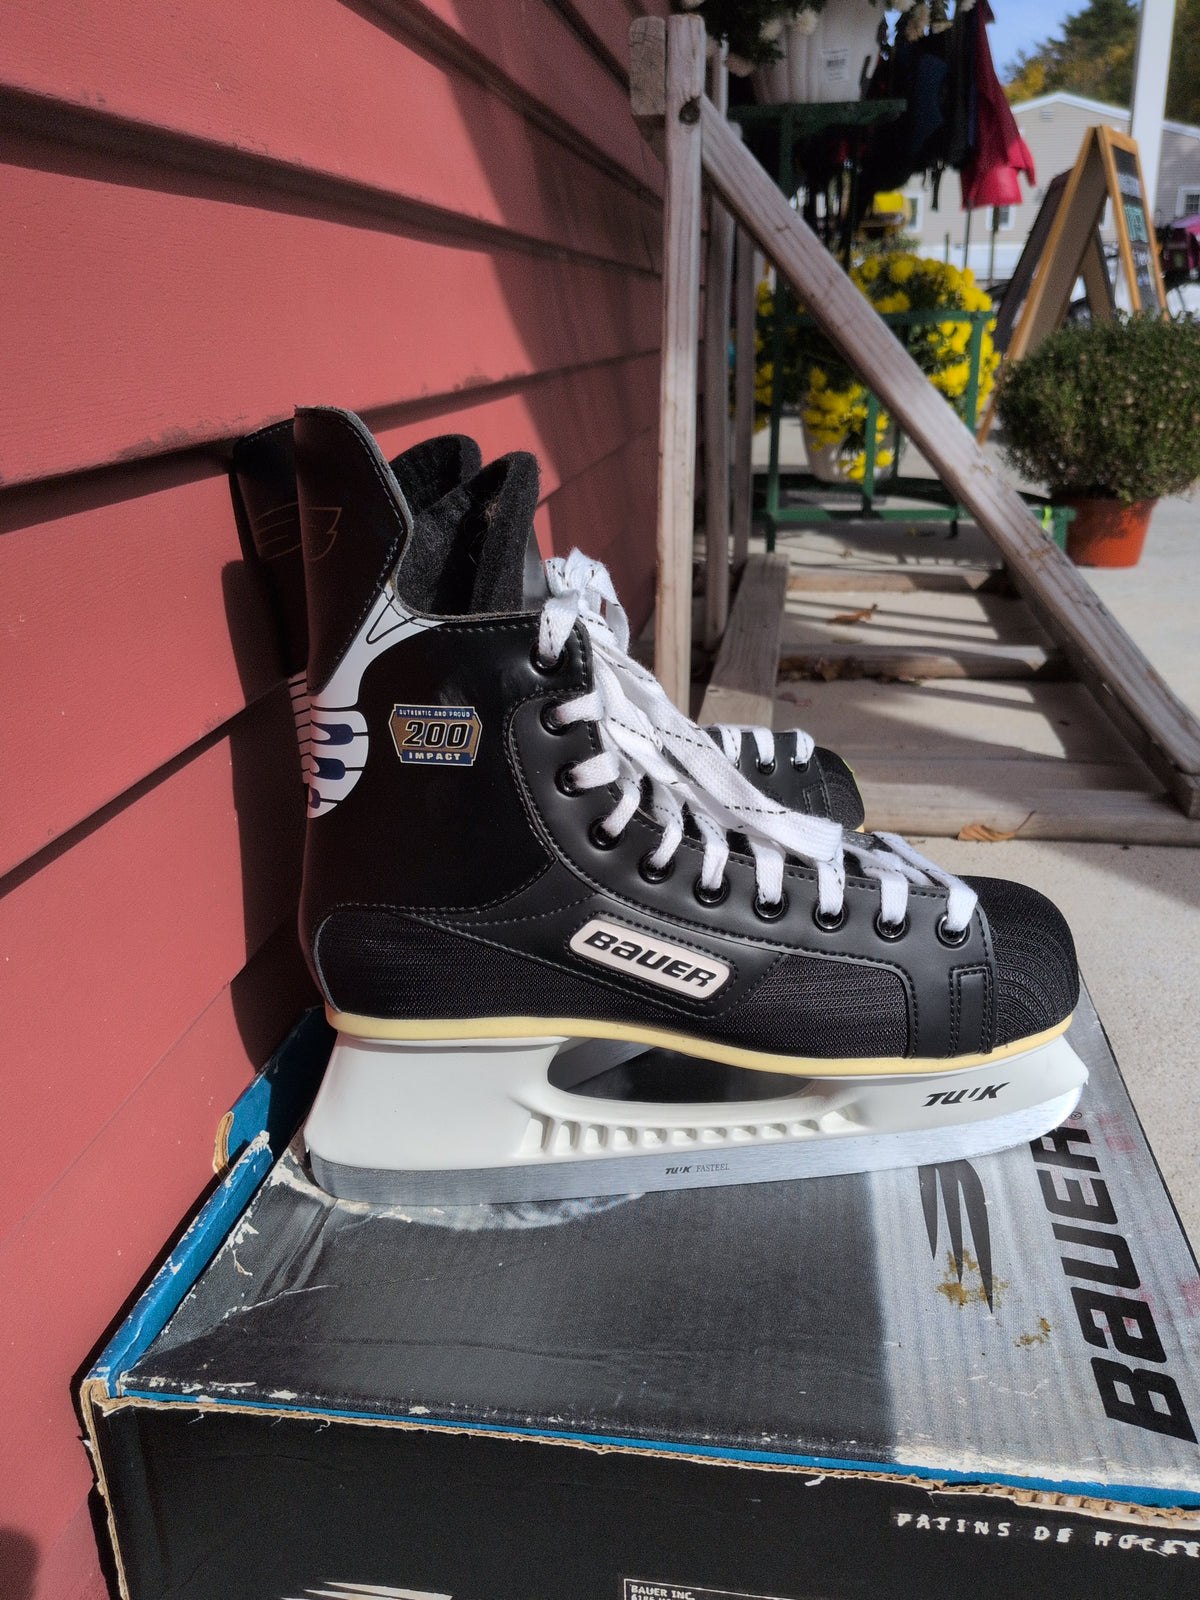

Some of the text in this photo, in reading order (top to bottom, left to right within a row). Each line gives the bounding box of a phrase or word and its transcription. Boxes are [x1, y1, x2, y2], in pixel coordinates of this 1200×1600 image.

[434, 710, 447, 718] AND
[402, 720, 470, 748] 200
[408, 752, 461, 760] IMPACT
[696, 1163, 730, 1173] FASTEEL
[894, 1512, 1011, 1537] PATINS
[1033, 1525, 1074, 1543] DE
[631, 1585, 668, 1597] BAUER
